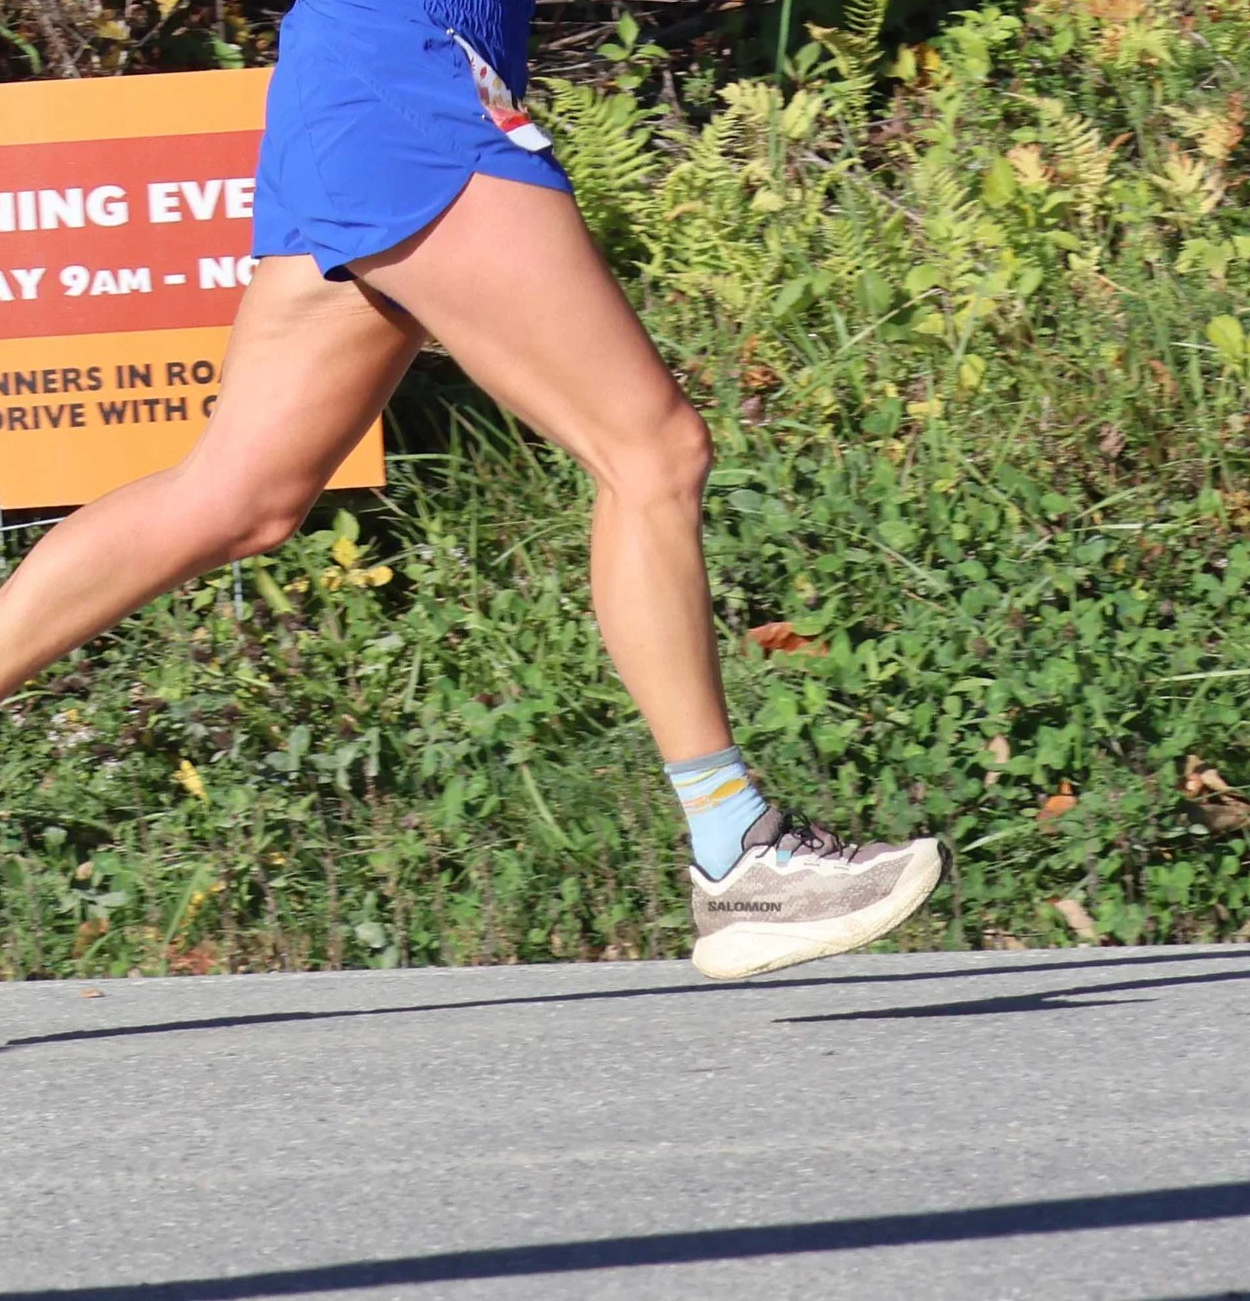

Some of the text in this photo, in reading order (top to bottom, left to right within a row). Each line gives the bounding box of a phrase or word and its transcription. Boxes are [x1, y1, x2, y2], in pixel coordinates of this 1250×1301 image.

[147, 178, 255, 223] EVE
[59, 265, 152, 296] 9AM
[116, 364, 152, 389] IN
[166, 360, 222, 386] RO
[98, 397, 188, 425] WITH
[707, 901, 782, 912] SALOMON
